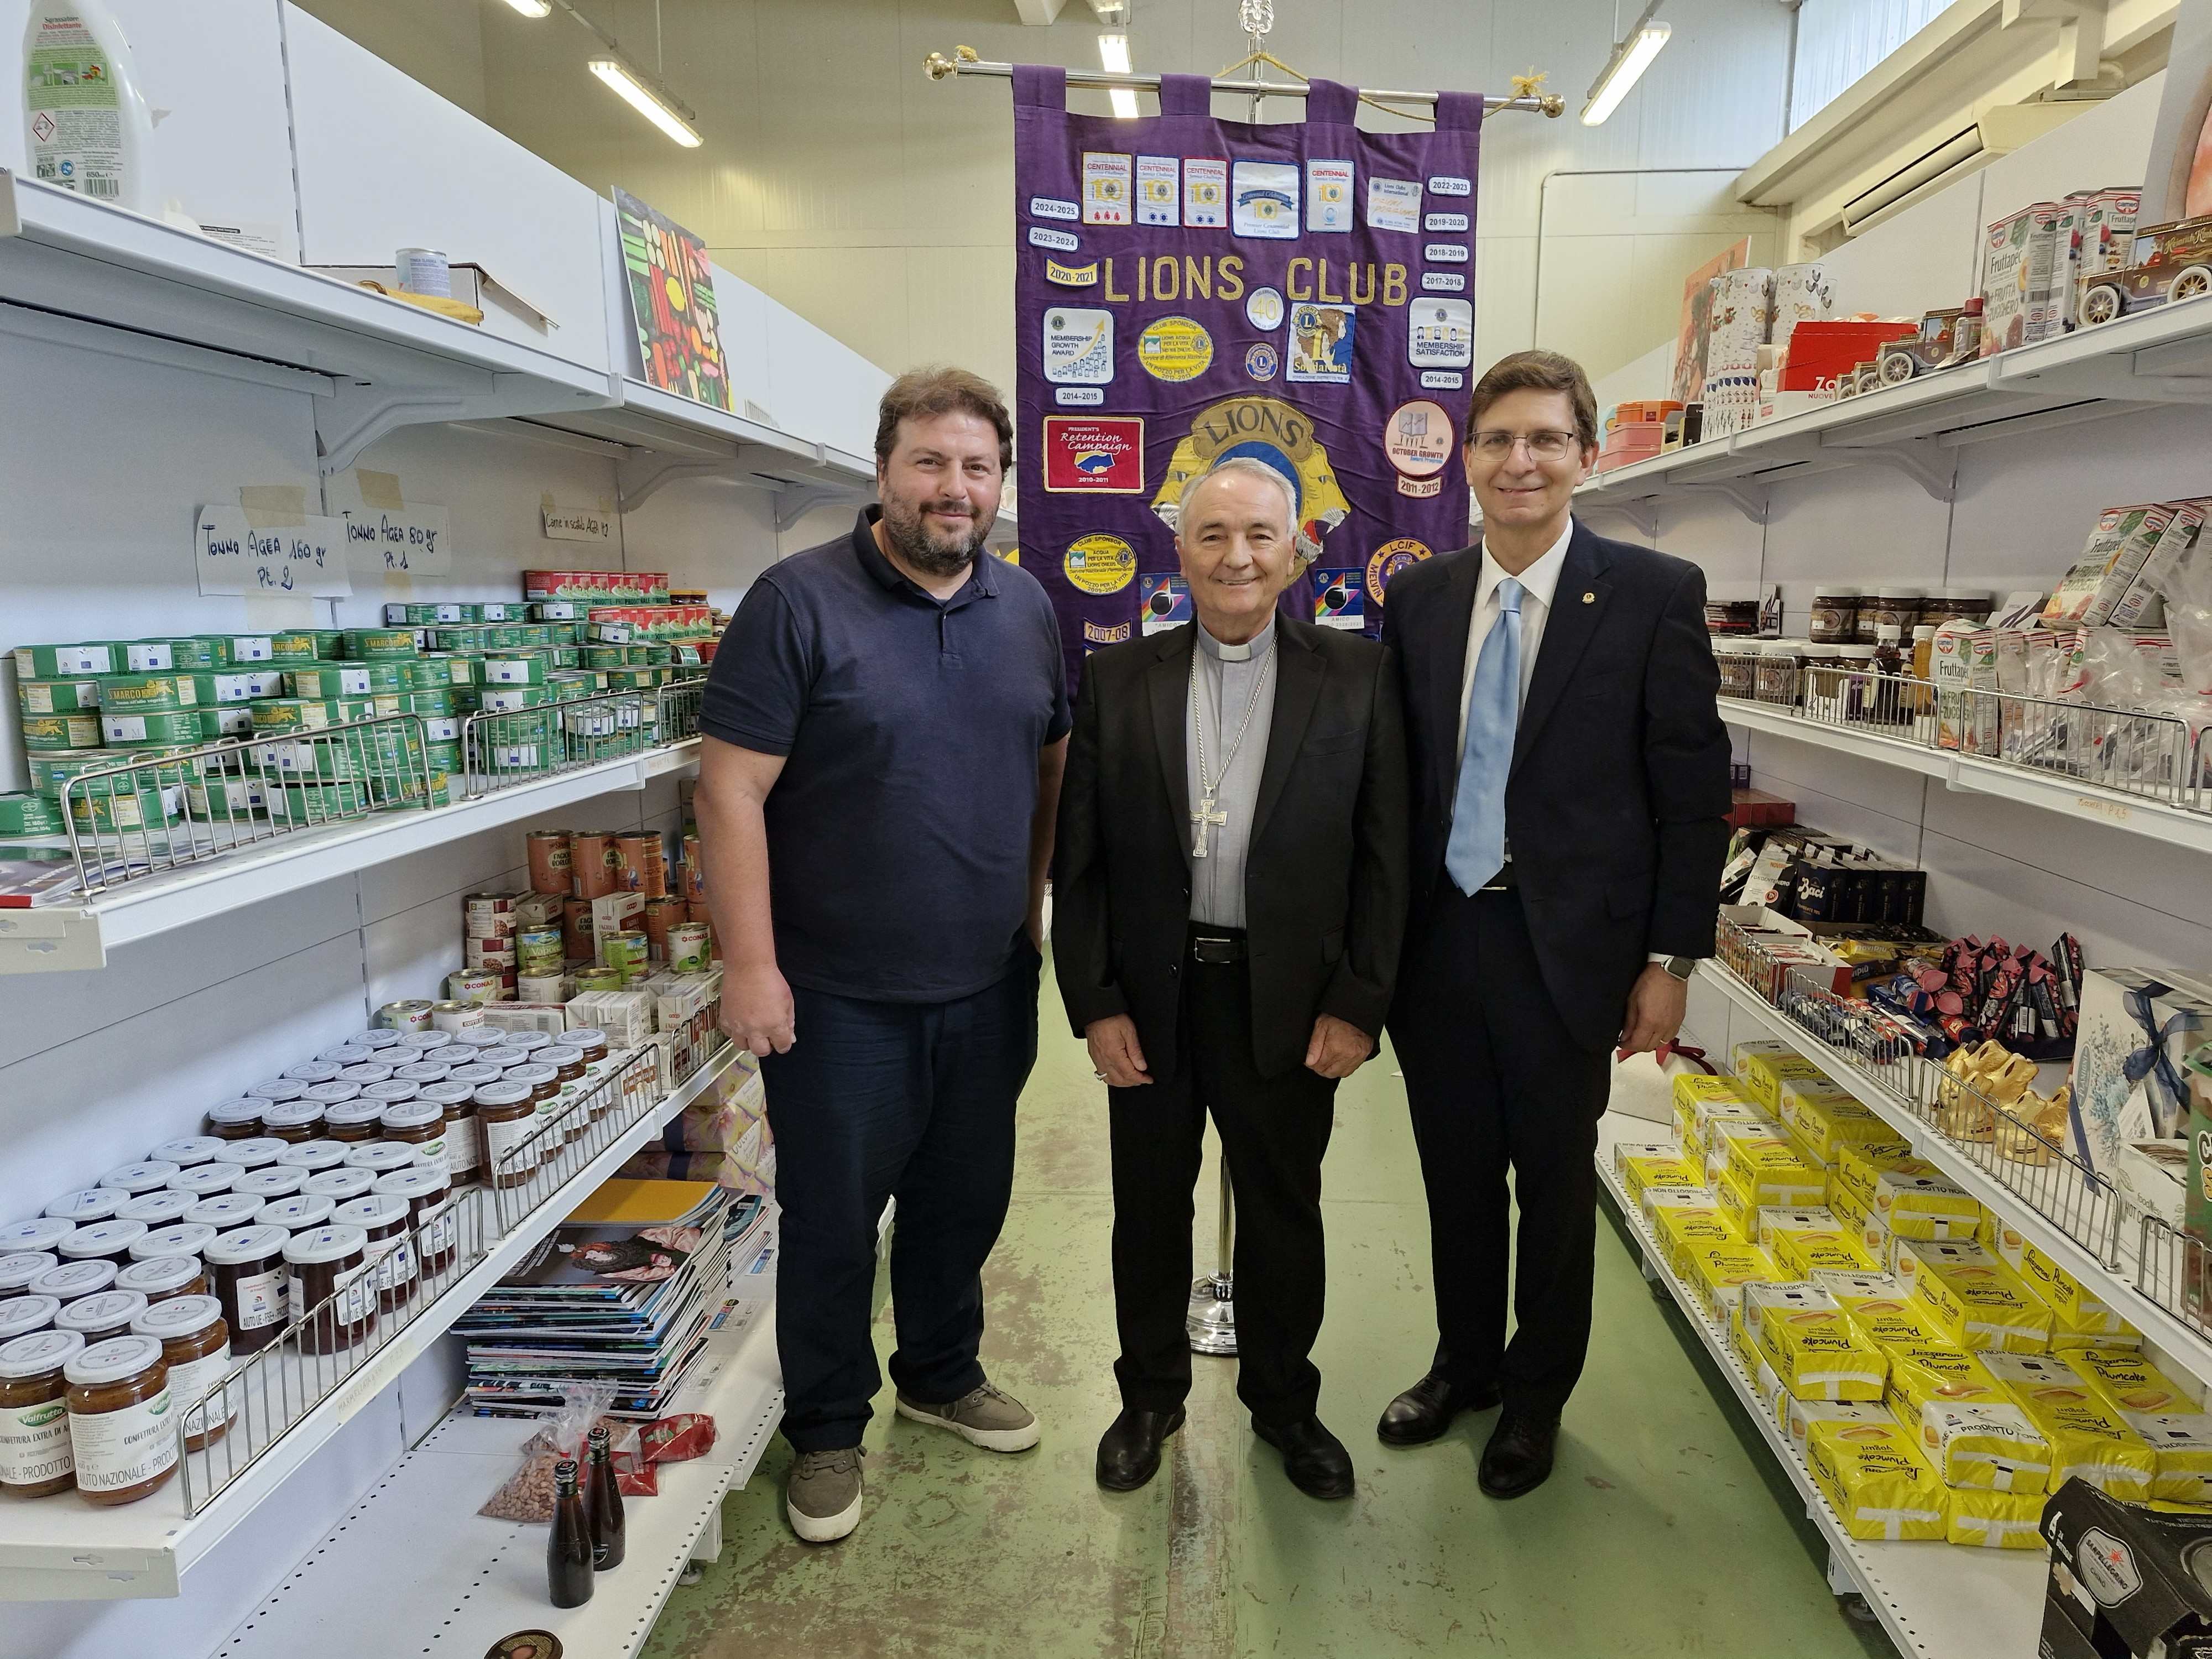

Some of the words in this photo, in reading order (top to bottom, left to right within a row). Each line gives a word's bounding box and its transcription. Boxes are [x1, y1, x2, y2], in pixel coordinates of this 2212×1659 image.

[1087, 163, 1127, 171] CENTENNIAL
[1433, 181, 1467, 191] 2022-2023
[1035, 202, 1075, 215] 2024-2025
[1034, 232, 1074, 247] 2023-2024
[1429, 248, 1464, 257] 2018-2019
[1991, 249, 2022, 274] Fruttapec
[1050, 267, 1093, 283] 2020-2021
[1104, 255, 1244, 302] LIONS
[1287, 257, 1407, 306] CLUB
[1426, 277, 1461, 286] 2017-2018
[1256, 289, 1279, 299] CELEBRATING
[1252, 297, 1278, 320] 40
[1153, 322, 1167, 331] CLUB
[1170, 321, 1197, 331] SPONSOR
[1305, 315, 1312, 327] L
[1416, 342, 1465, 350] MEMBERSHIP
[1154, 366, 1172, 374] POZZO
[1193, 360, 1206, 369] VITA
[1259, 357, 1265, 367] L
[1425, 375, 1459, 384] 2014-2015
[1203, 404, 1305, 448] LIONS
[1061, 432, 1123, 442] Retention
[1068, 441, 1131, 455] Campaign
[1392, 447, 1417, 456] OCTOBER
[1419, 450, 1443, 459] GROWTH
[1401, 480, 1438, 494] 2011-2012
[409, 528, 423, 544] 80
[426, 530, 437, 553] gr
[1078, 538, 1092, 546] CLUB
[1095, 536, 1121, 546] SPONSOR
[1390, 541, 1416, 552] LCIF
[248, 530, 281, 557] AGEA
[289, 540, 311, 560] 160
[316, 547, 326, 568] gr
[281, 565, 293, 589] 2
[1074, 574, 1081, 582] UN
[1082, 579, 1099, 588] POZZO
[1118, 573, 1128, 582] VITA
[1369, 564, 1383, 598] MELVIN
[1088, 625, 1129, 641] 2007-08
[1940, 661, 1969, 681] Fruttapec
[1798, 877, 1825, 899] Baci
[471, 980, 494, 989] CONAD
[1809, 1253, 1854, 1261] Plumcake
[1965, 1289, 2016, 1300] Plumcake
[243, 1316, 256, 1327] AIUTO
[257, 1314, 262, 1324] UE
[264, 1311, 275, 1322] FSE+
[1872, 1326, 1921, 1336] Plumcake
[1803, 1337, 1851, 1349] Plumcake
[1906, 1348, 1968, 1360] Lazzaroni
[2081, 1351, 2143, 1368] Lazzaroni
[1919, 1359, 1971, 1372] Plumcake
[2094, 1366, 2147, 1381] Plumcake
[22, 1407, 64, 1423] Valfrutta
[33, 1431, 53, 1442] EXTRA
[55, 1427, 61, 1436] DI
[124, 1427, 160, 1445] CONFETTURA
[1961, 1425, 2014, 1436] PRODOTTO
[1858, 1454, 1911, 1465] Plumcake
[23, 1457, 70, 1478] PRODOTTO
[79, 1473, 97, 1486] AIUTO
[100, 1467, 147, 1485] NAZIONALE
